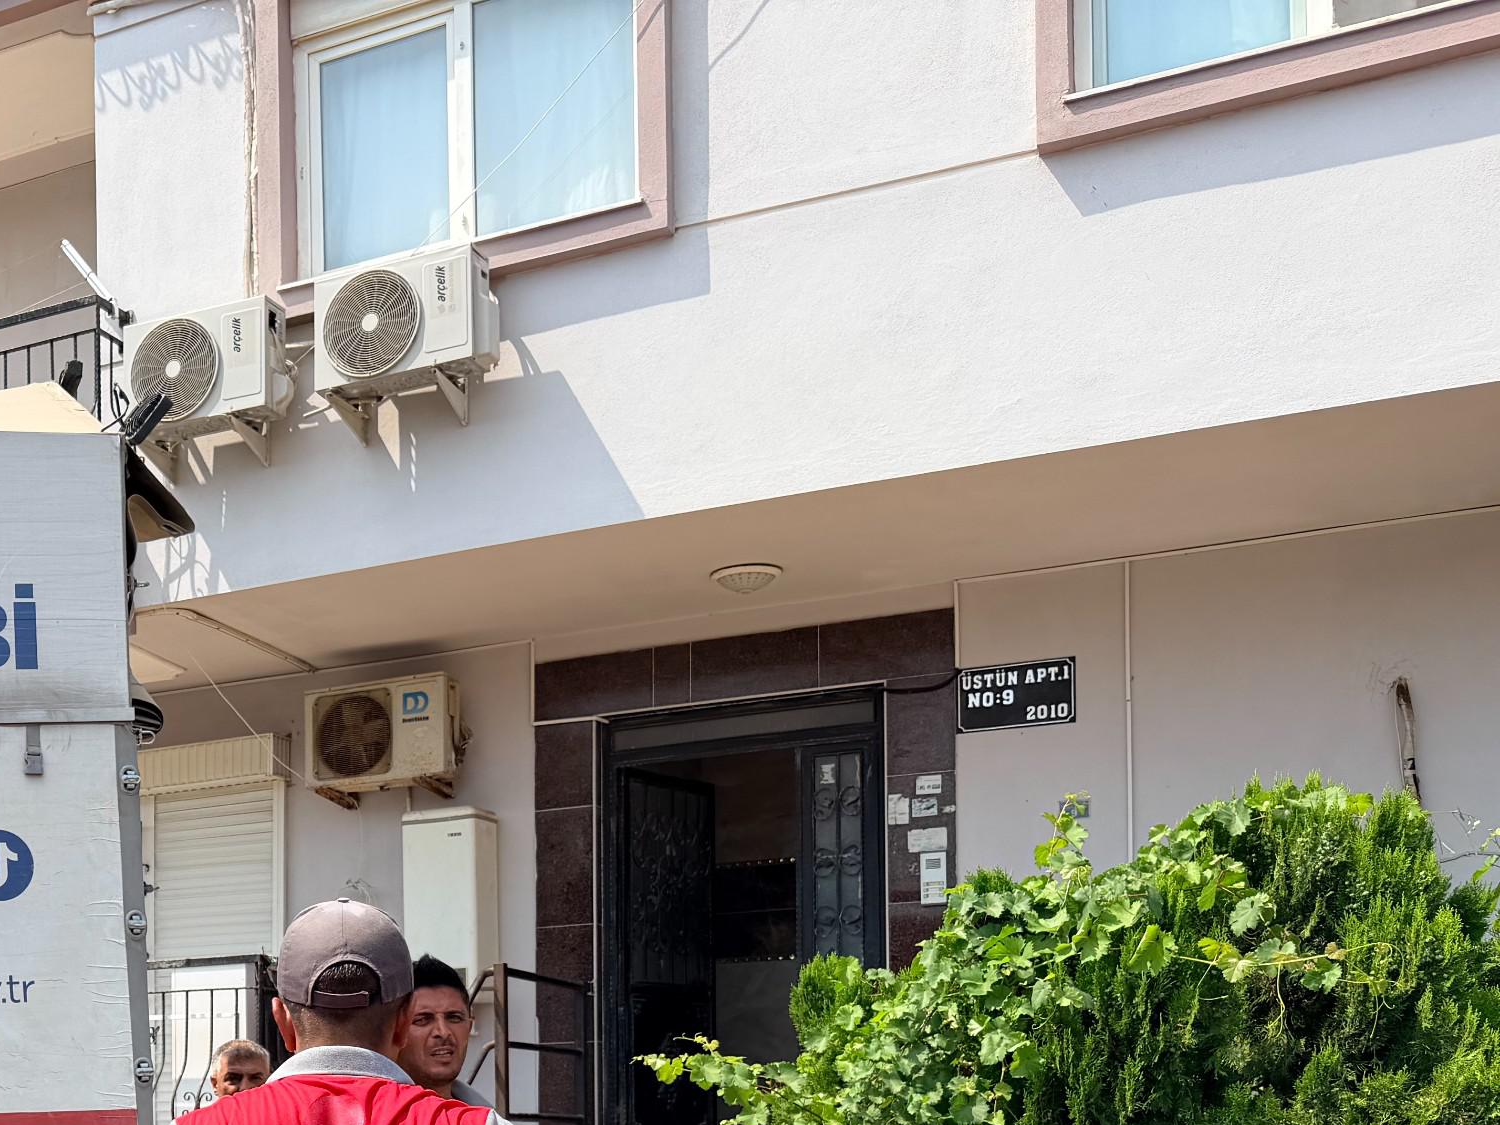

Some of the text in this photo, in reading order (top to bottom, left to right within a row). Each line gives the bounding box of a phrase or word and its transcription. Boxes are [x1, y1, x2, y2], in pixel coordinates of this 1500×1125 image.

[435, 264, 447, 302] arçelik
[231, 317, 242, 353] arçelik
[961, 669, 1018, 691] ÜSTÜN
[967, 689, 1015, 708] NO:9
[1026, 702, 1069, 721] 2010
